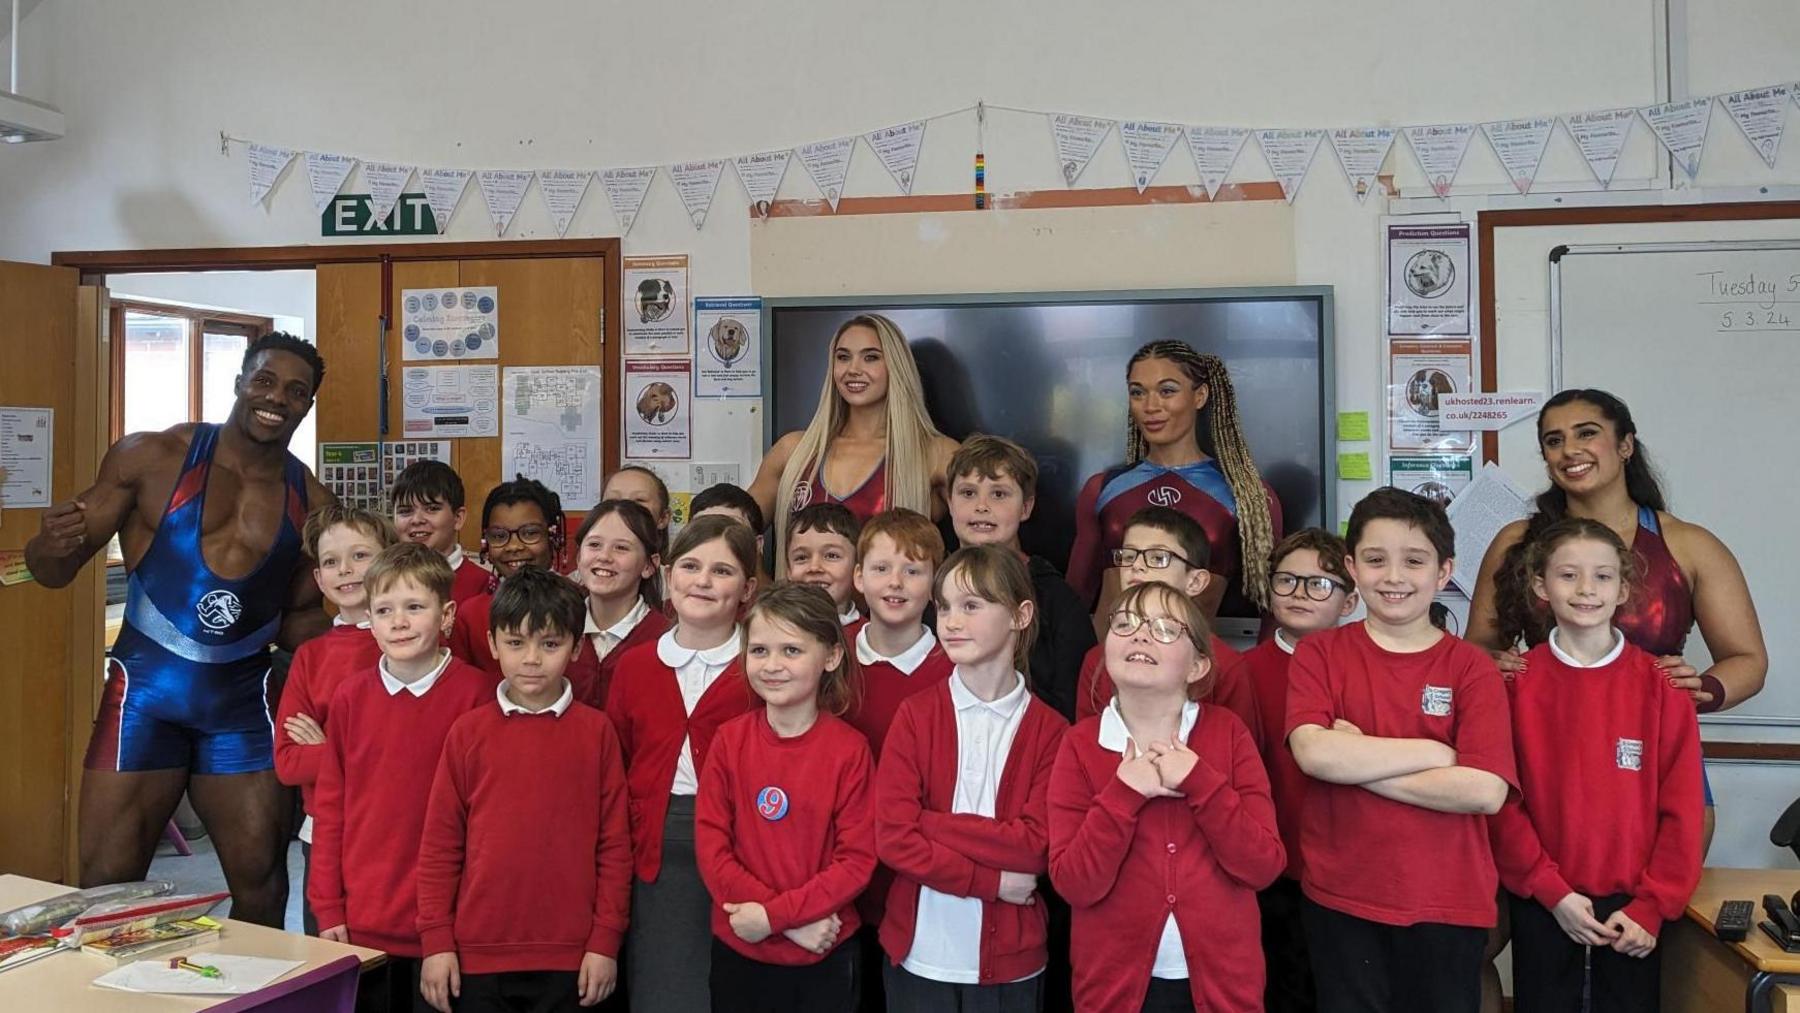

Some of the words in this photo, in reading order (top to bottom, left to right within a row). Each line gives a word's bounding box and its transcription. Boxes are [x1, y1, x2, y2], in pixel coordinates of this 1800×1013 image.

[1728, 95, 1741, 104] All
[1744, 90, 1770, 101] About
[1772, 87, 1786, 97] Me
[1649, 108, 1661, 117] All
[1570, 115, 1582, 124] All
[1585, 113, 1612, 122] About
[1124, 122, 1135, 131] All
[1505, 122, 1531, 131] About
[1335, 130, 1347, 138] All
[1349, 130, 1375, 138] About
[320, 154, 340, 162] About
[738, 157, 748, 165] All
[672, 165, 683, 173] All
[336, 198, 428, 231] EXIT
[1696, 271, 1776, 310] Tuesday
[1445, 397, 1536, 406] ukhosted23.renlearn.
[1446, 412, 1508, 421] co.uk/2248265
[761, 789, 784, 817] 9
